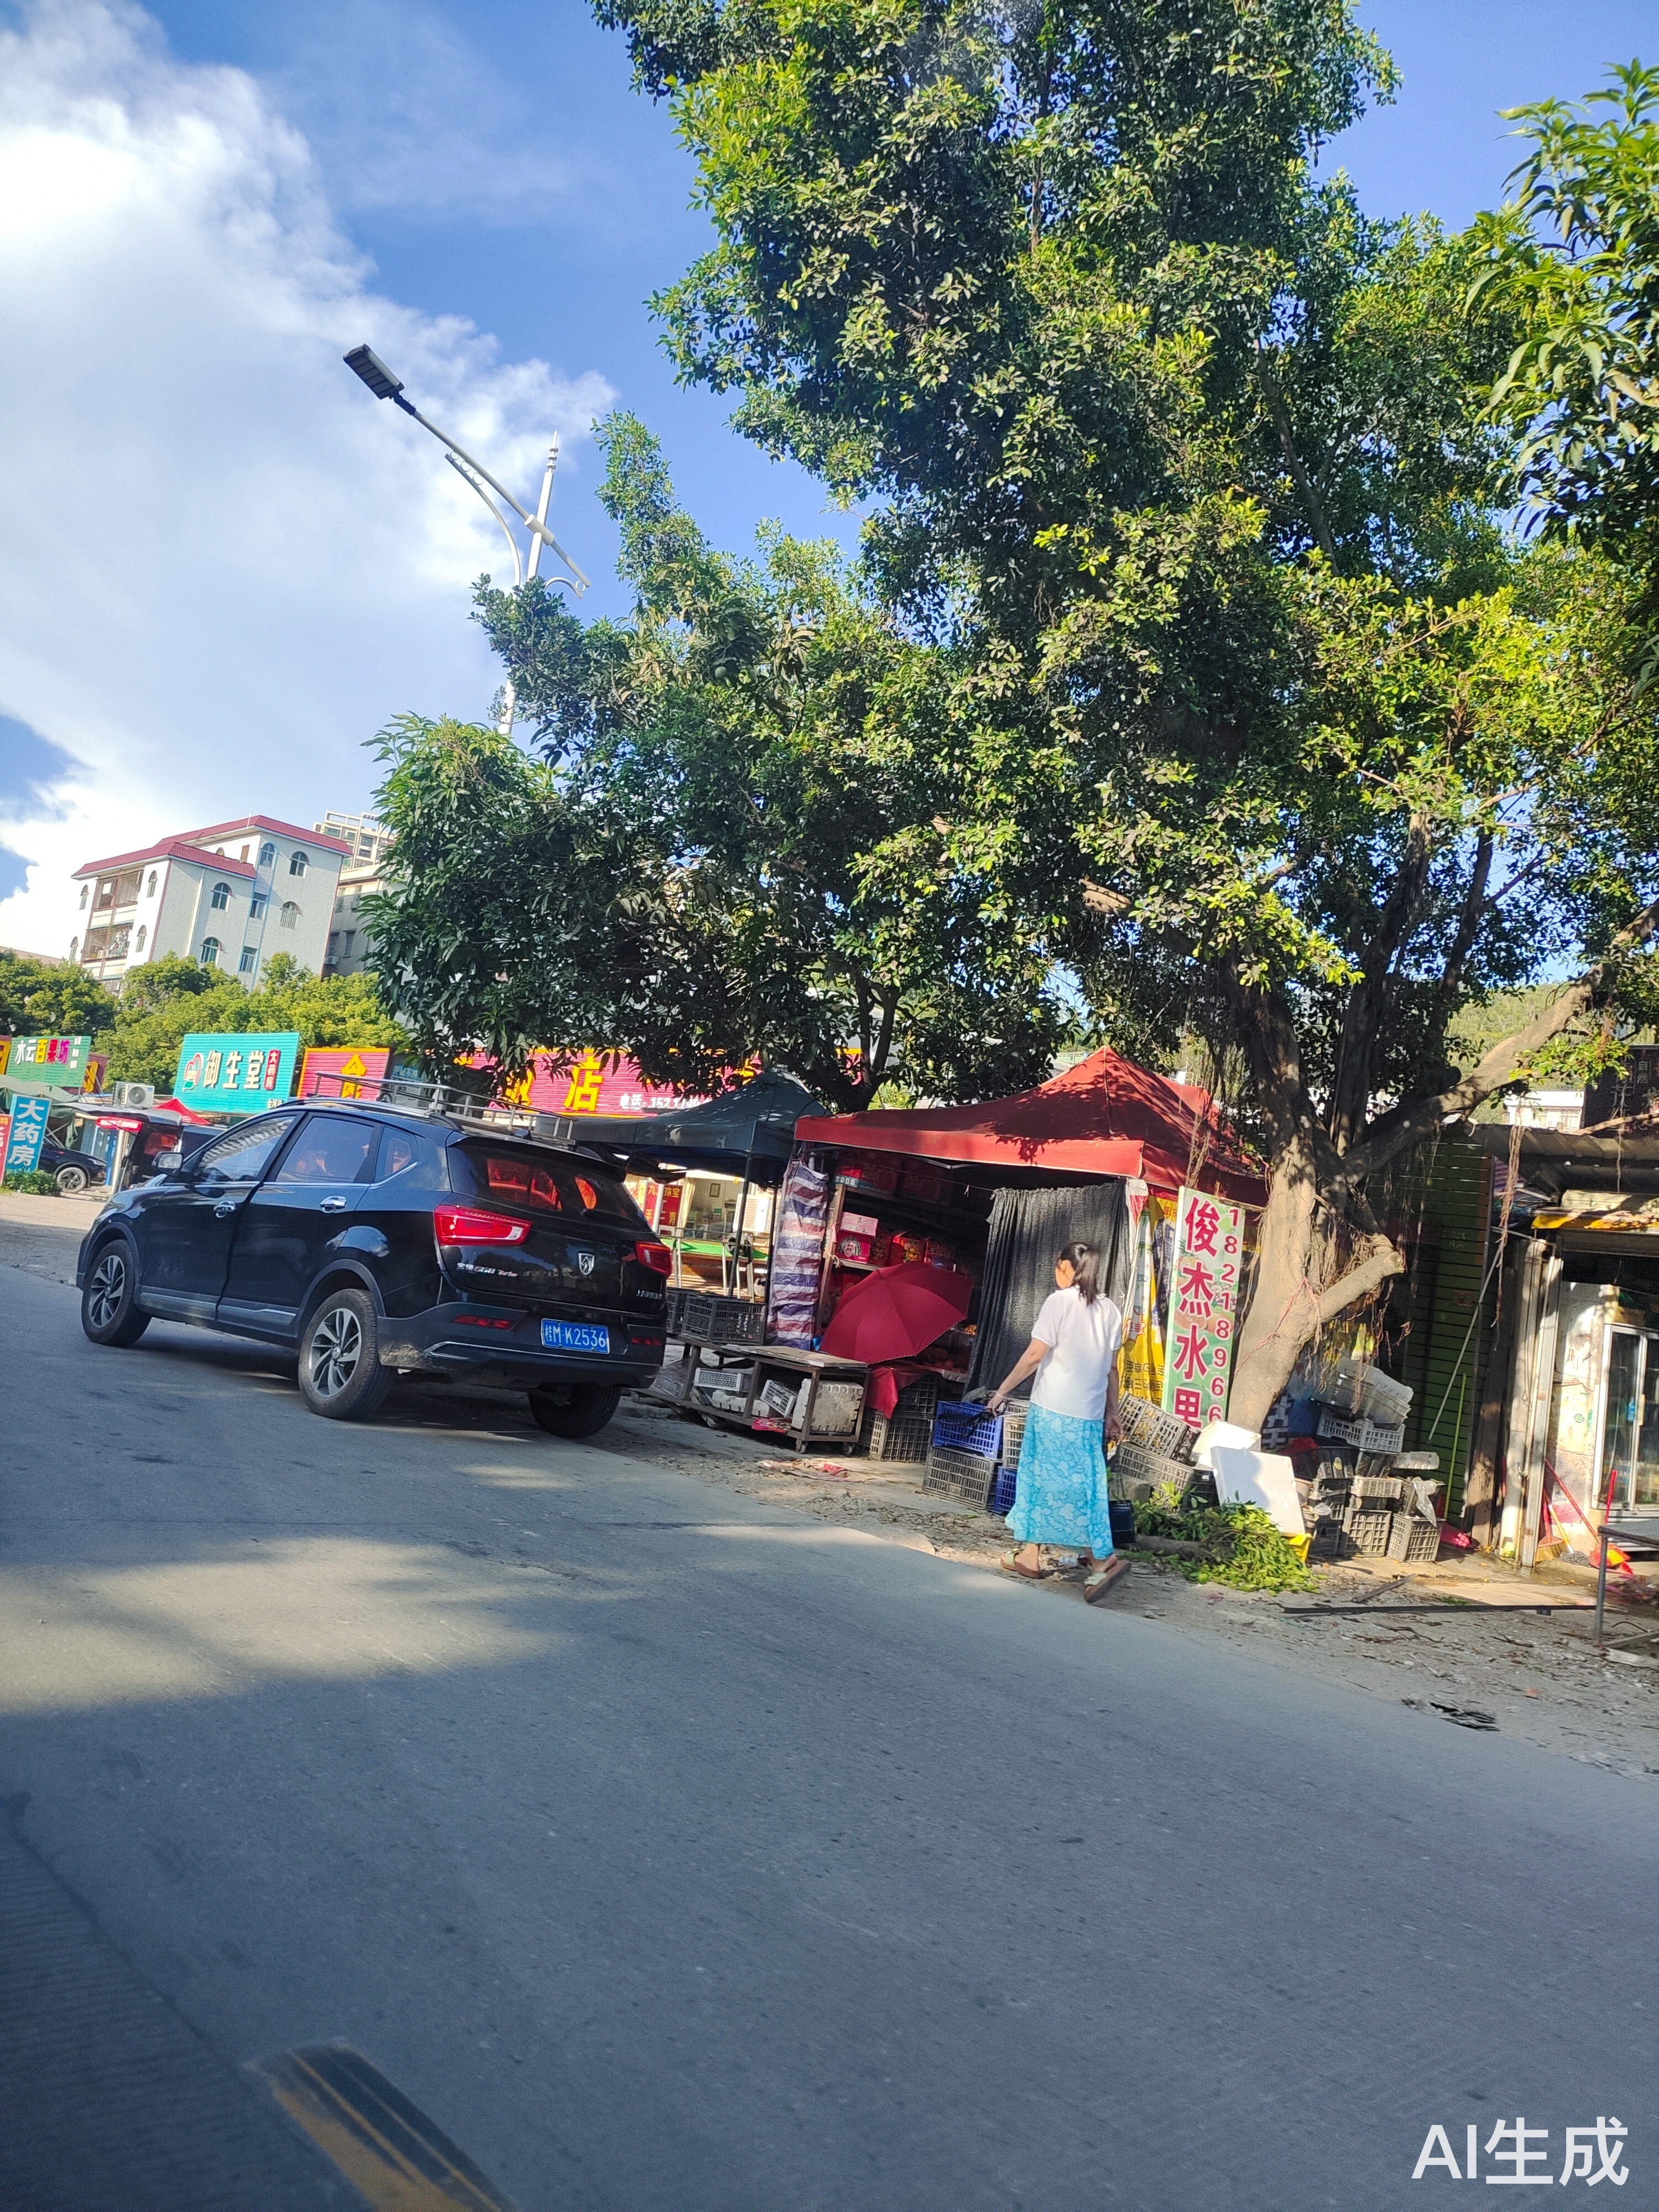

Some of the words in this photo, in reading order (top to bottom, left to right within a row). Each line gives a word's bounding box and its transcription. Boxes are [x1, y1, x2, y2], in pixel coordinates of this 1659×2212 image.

[14, 1039, 70, 1065] 水云百果坊
[204, 1050, 264, 1089] 御生堂
[265, 1052, 278, 1088] 大药房
[8, 1100, 45, 1167] 大药房
